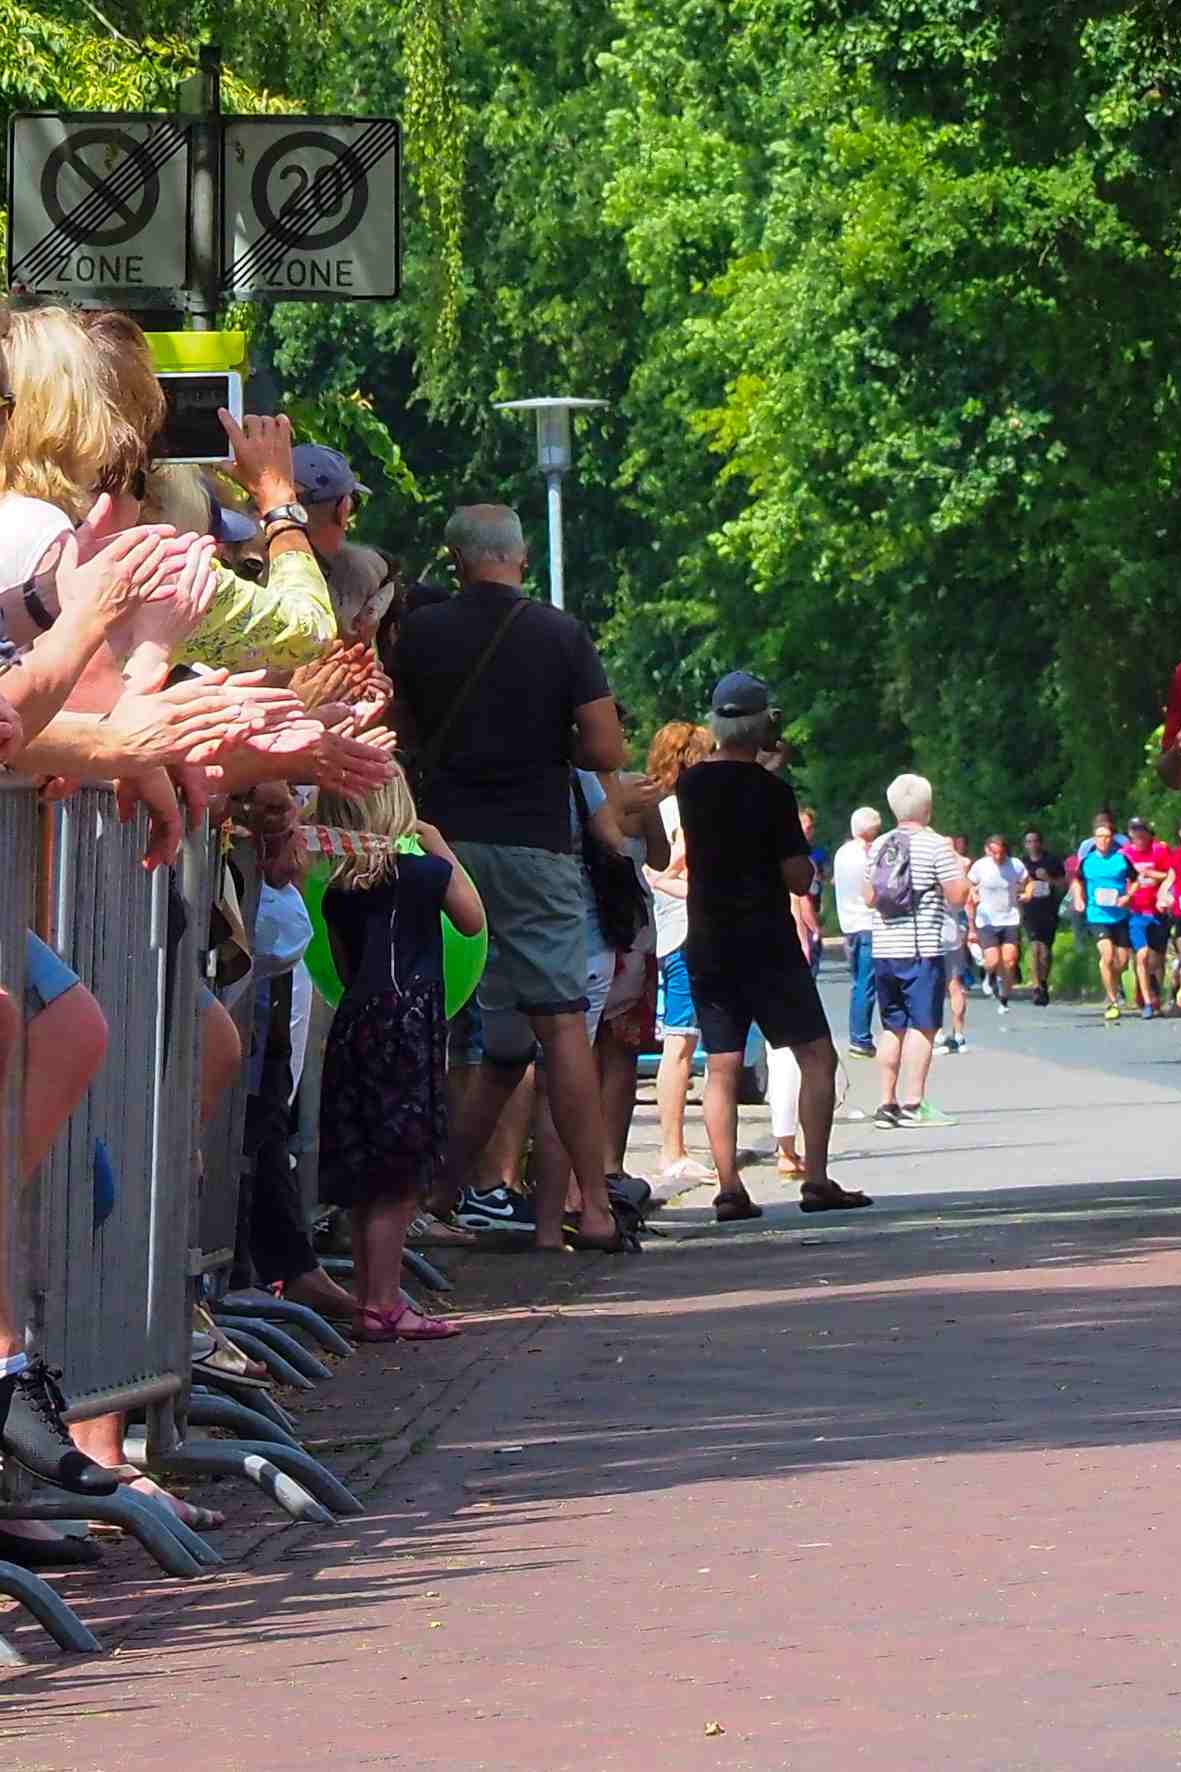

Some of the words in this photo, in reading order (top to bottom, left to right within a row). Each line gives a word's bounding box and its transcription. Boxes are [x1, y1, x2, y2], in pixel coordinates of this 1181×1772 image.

[279, 164, 342, 218] 20
[56, 255, 145, 283] ZONE
[267, 259, 354, 287] ZONE
